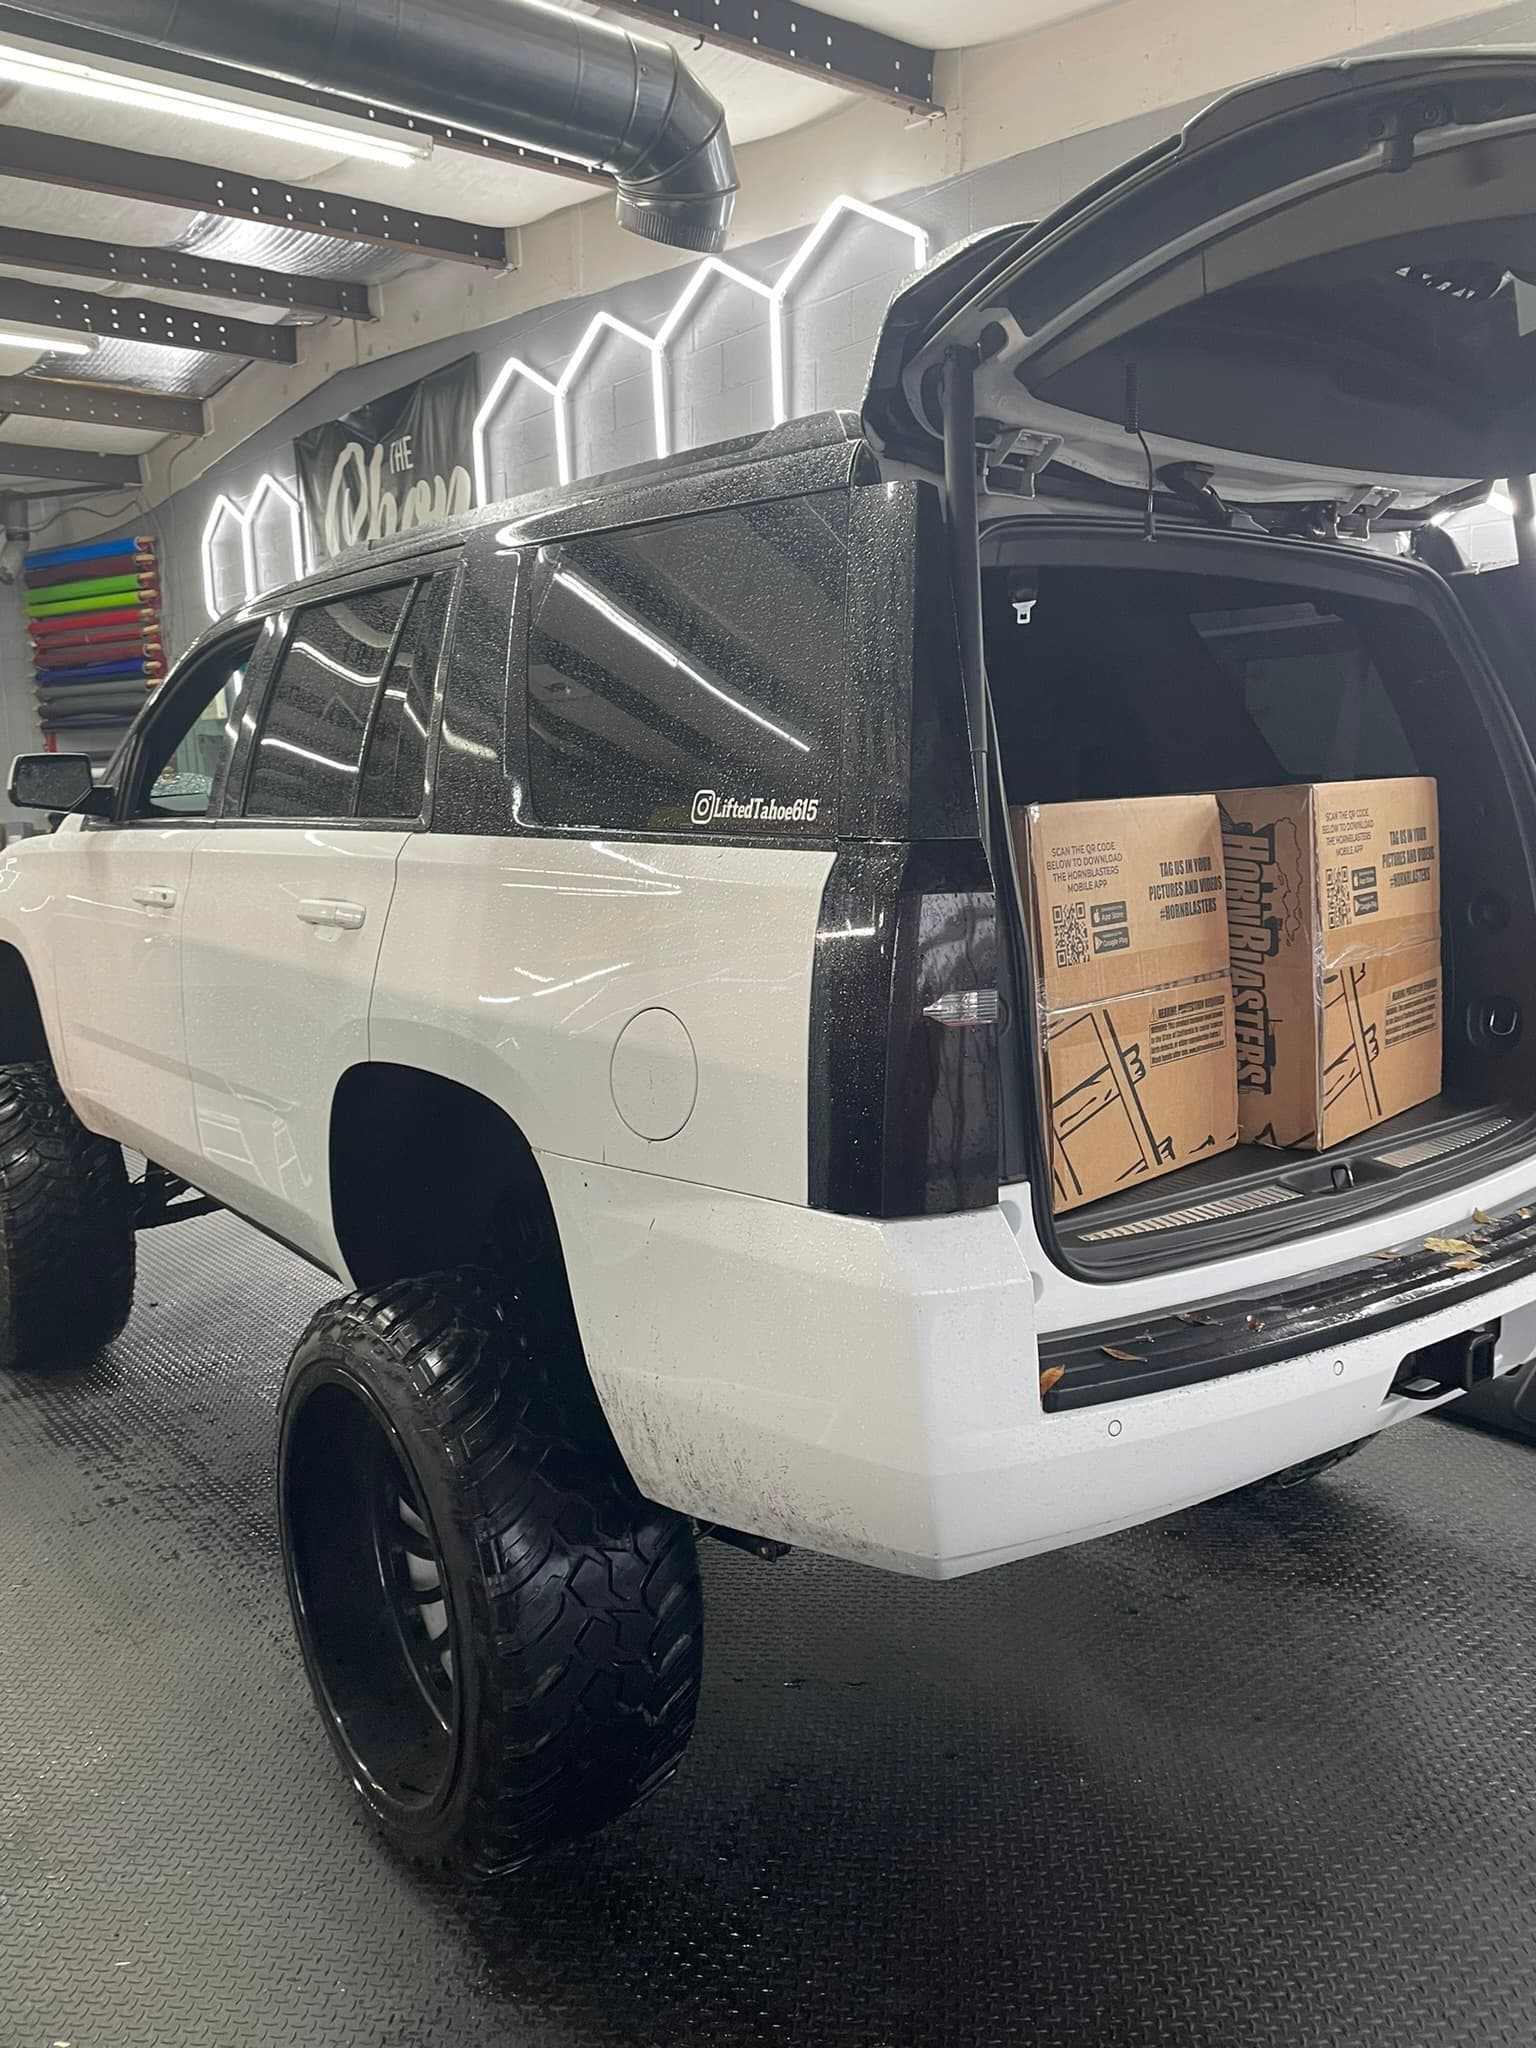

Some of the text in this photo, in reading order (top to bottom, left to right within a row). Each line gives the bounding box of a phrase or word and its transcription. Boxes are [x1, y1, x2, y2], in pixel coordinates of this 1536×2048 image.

[389, 435, 414, 474] THE
[713, 797, 819, 822] LiftedTahoe615
[1051, 841, 1116, 857] SCAN THE QR CODE
[1046, 852, 1123, 871] BELOW TO DOWNLOAD
[1159, 856, 1212, 878] TAG US IN YOUR
[1053, 865, 1119, 882] THE HORNBLASTERS
[1067, 879, 1108, 893] MOBILE APP
[1149, 875, 1223, 902] PICTURES AND VIDEOS
[1160, 897, 1217, 921] #HORNBLASTERS
